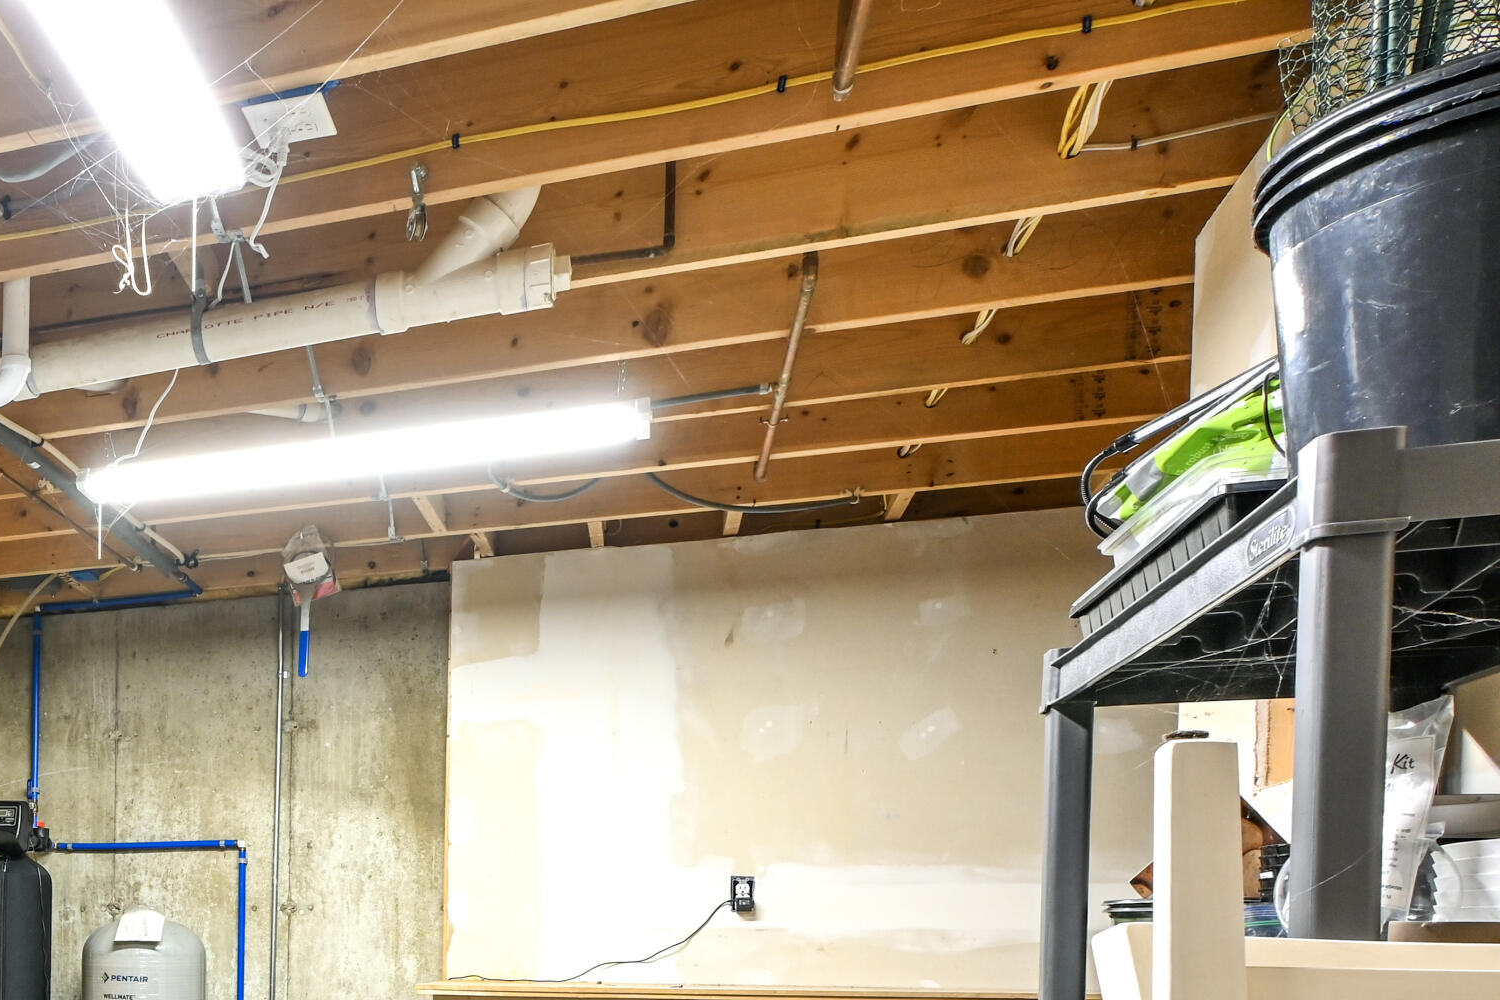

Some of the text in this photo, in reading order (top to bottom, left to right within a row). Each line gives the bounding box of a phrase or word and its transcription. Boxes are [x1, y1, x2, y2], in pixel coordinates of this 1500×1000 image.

[156, 300, 336, 339] CHAROTTE PIPE N/E
[1249, 523, 1290, 562] Sterilite
[1390, 753, 1416, 774] Kit
[110, 974, 149, 983] PENTAIR
[103, 993, 134, 1000] WELLMATE
